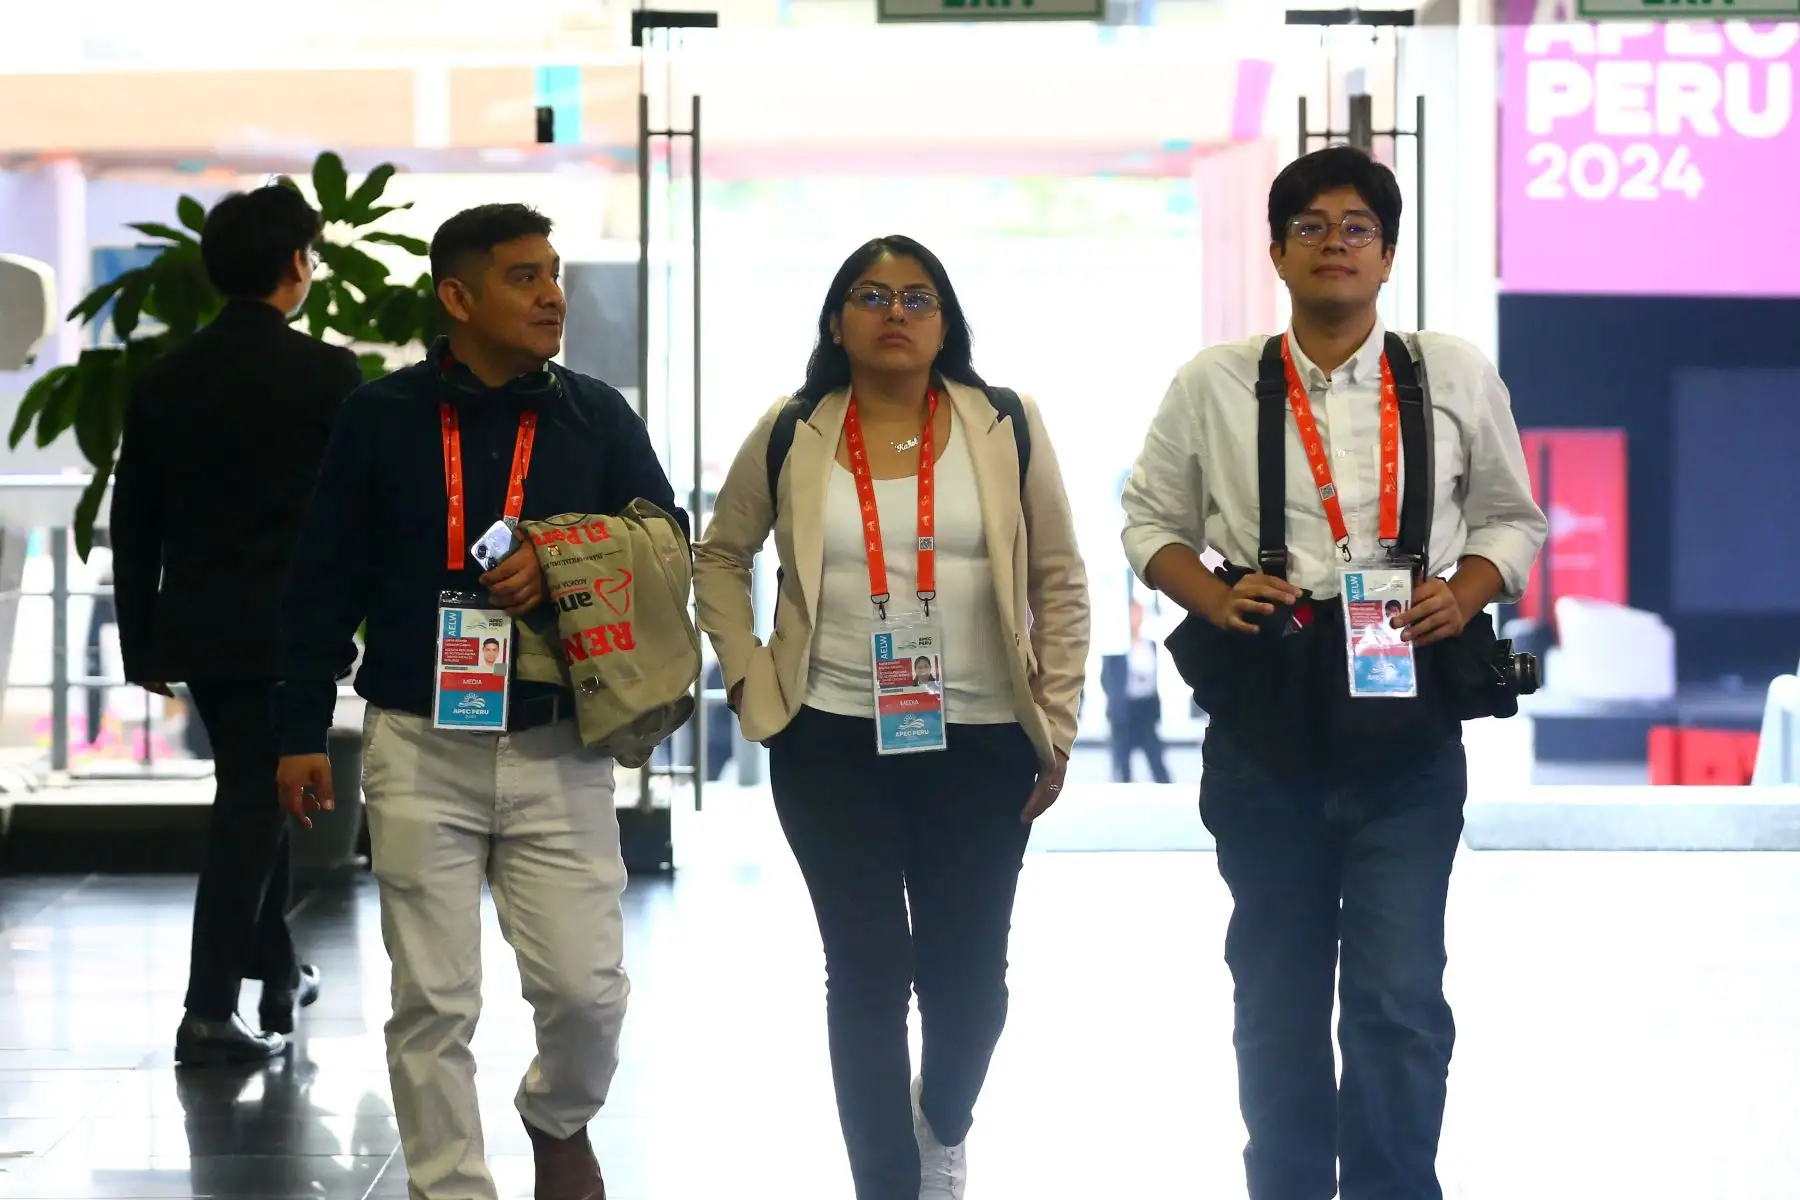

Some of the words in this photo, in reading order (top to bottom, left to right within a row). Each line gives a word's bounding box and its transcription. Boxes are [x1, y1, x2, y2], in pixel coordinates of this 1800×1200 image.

[1526, 59, 1793, 138] PERU
[1526, 142, 1705, 200] 2024
[1350, 575, 1360, 600] AELW
[448, 612, 457, 636] AELW
[880, 635, 889, 659] AELW
